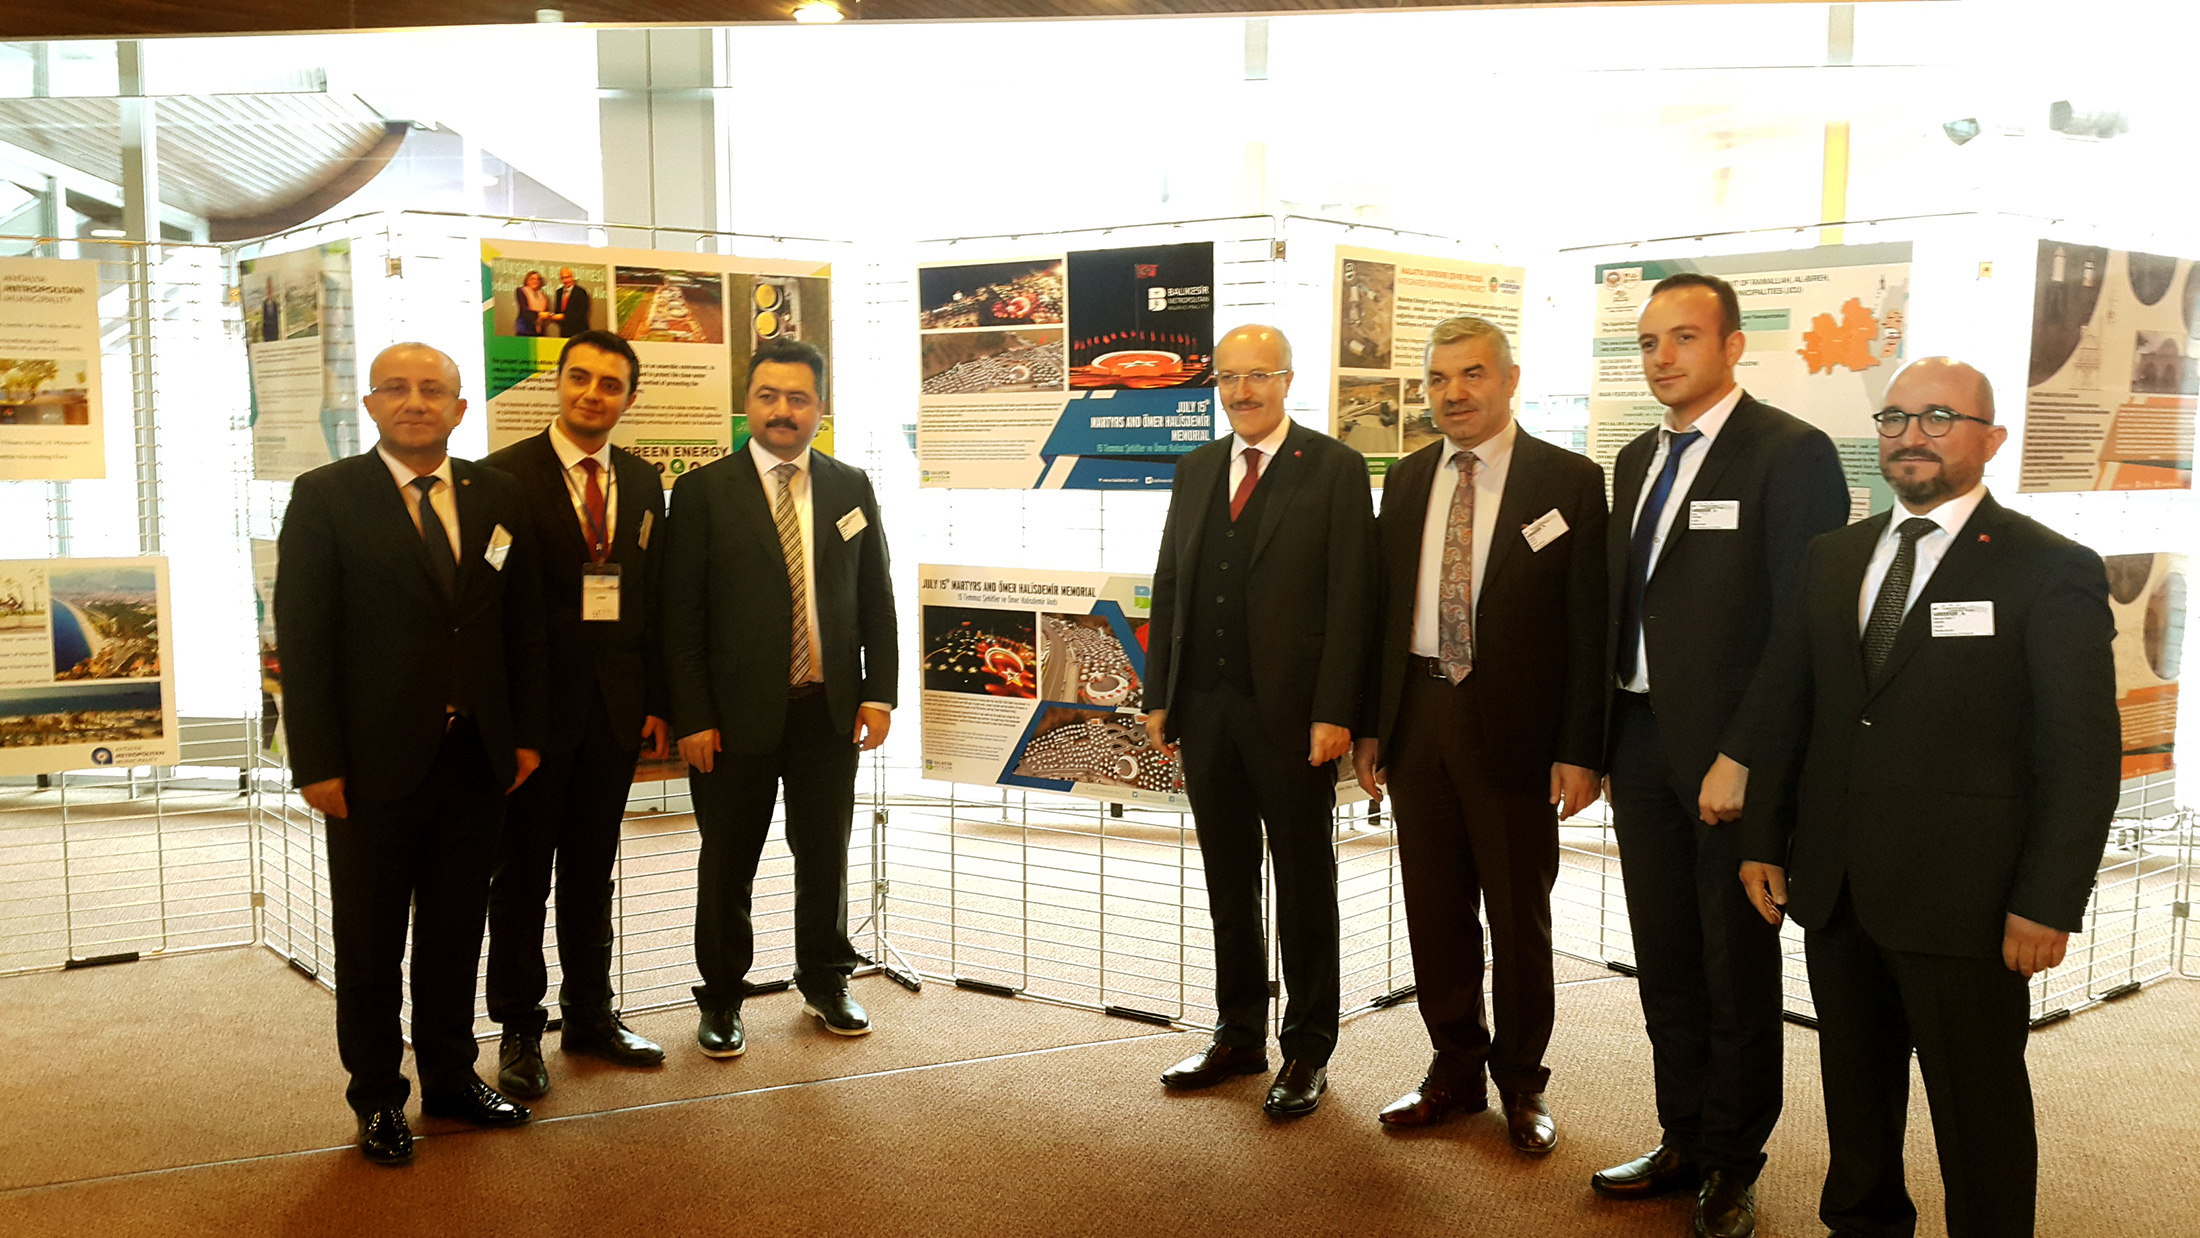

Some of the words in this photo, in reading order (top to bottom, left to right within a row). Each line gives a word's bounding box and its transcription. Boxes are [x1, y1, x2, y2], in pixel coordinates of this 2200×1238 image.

[1176, 401, 1197, 413] JULY
[1090, 416, 1125, 429] MARTYRS
[1125, 416, 1142, 428] AND
[1171, 430, 1211, 441] MEMORIAL
[673, 446, 729, 457] ENERGY
[922, 578, 938, 589] JULY
[951, 580, 982, 592] MARTYRS
[983, 581, 997, 592] AND
[998, 581, 1017, 593] ÖMER
[1061, 585, 1097, 598] MEMORIAL
[115, 751, 165, 759] METROPOLITAN
